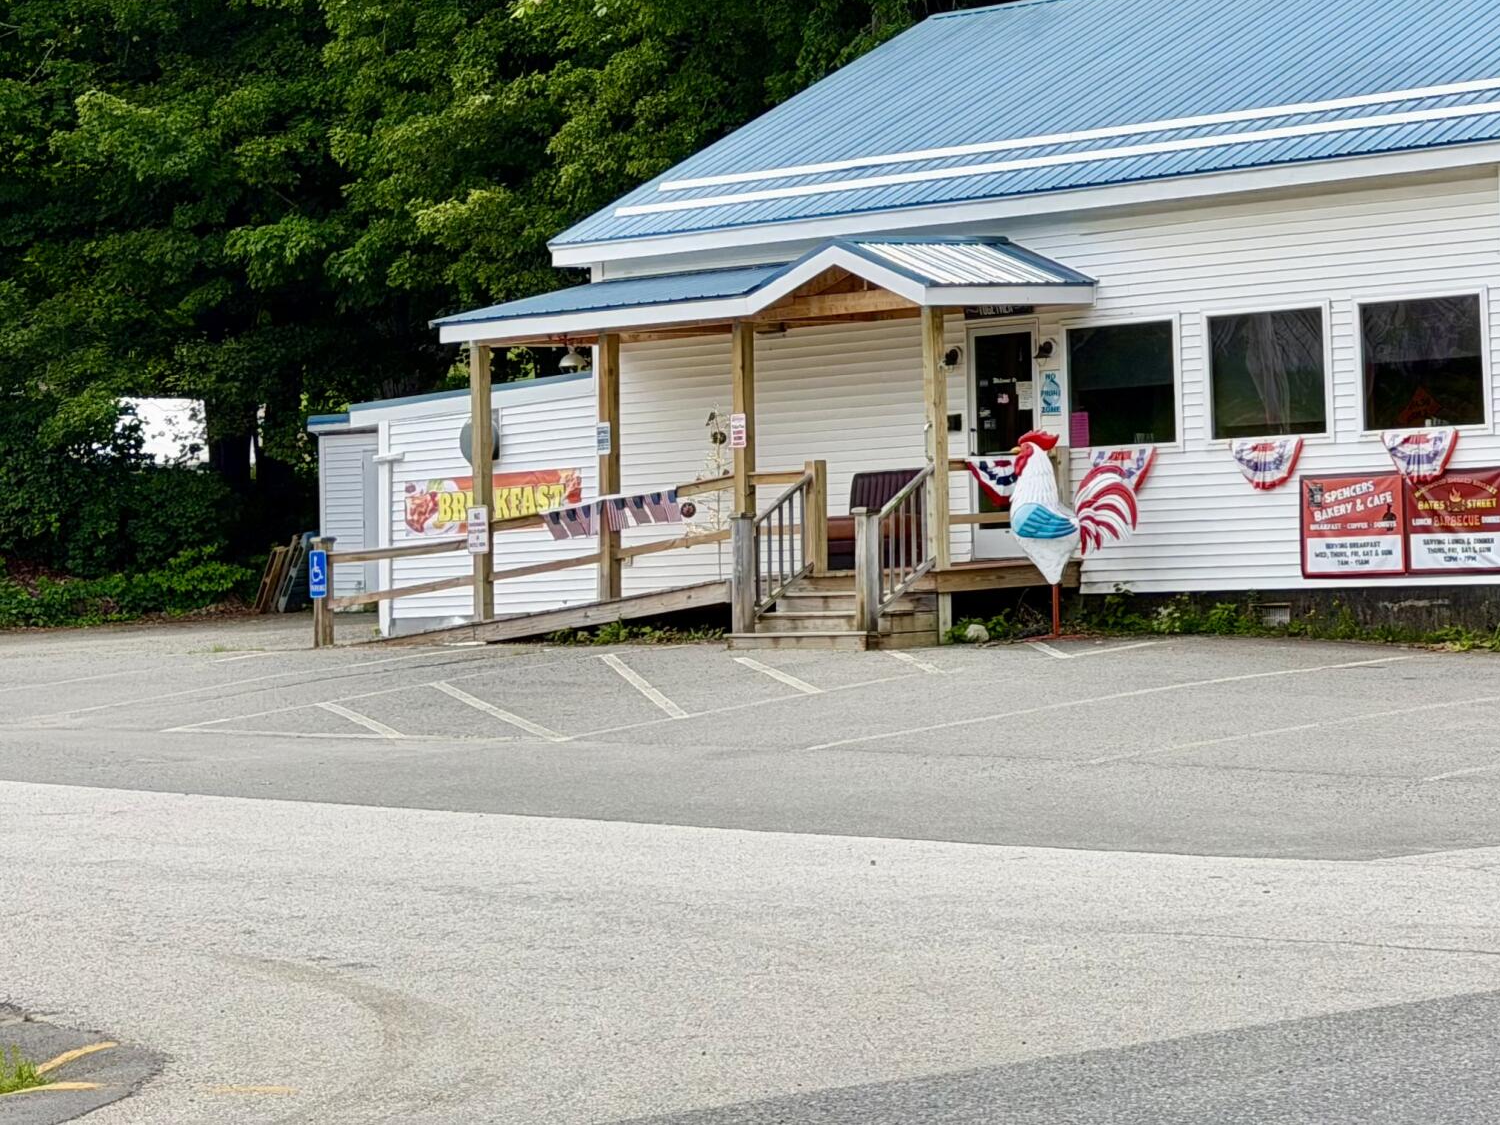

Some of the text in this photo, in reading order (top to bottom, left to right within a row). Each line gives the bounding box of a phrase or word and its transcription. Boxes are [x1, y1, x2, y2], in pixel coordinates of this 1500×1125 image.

[1324, 481, 1374, 503] SPENCERS
[1314, 491, 1393, 522] BAKERY & CAFE
[1418, 498, 1497, 510] BATES STREET
[1433, 514, 1480, 527] BARBECUE
